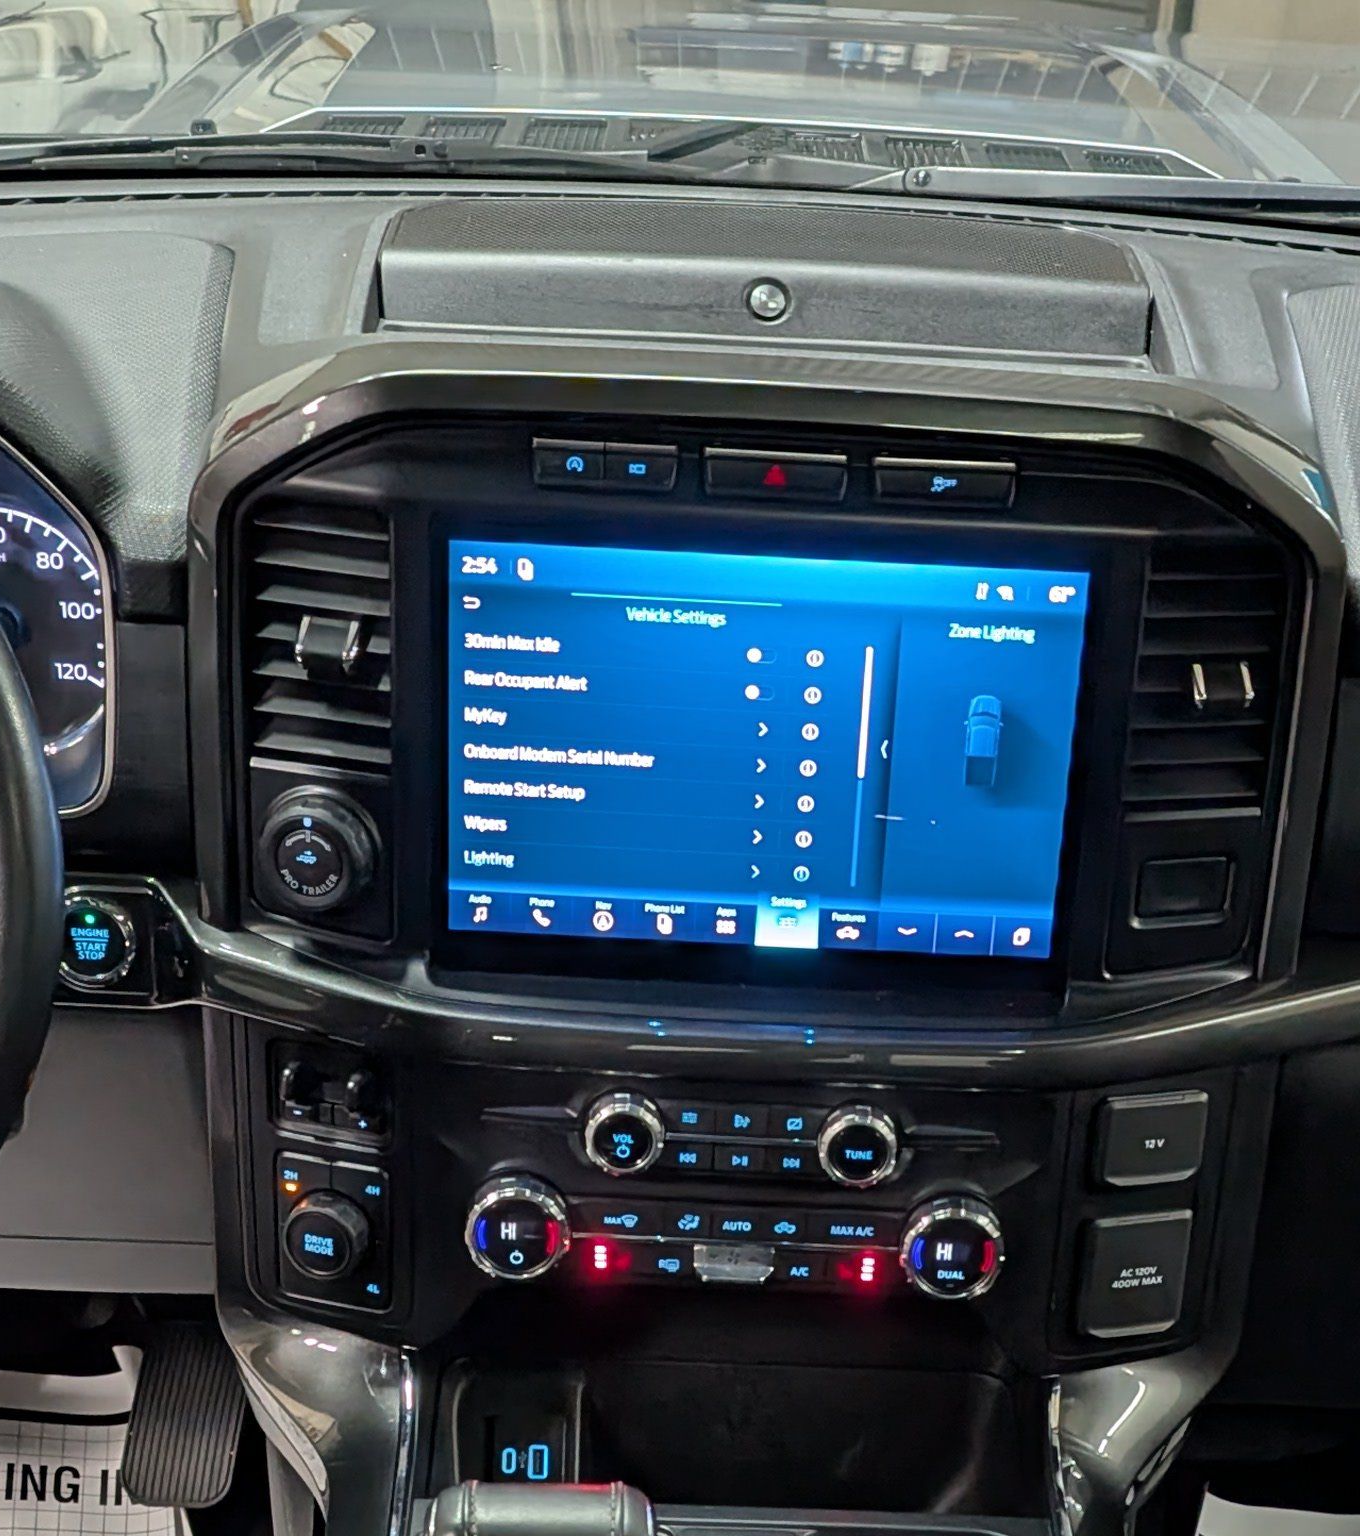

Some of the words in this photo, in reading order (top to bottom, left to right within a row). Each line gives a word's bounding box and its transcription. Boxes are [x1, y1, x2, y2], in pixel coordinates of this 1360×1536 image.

[36, 552, 64, 570] 80
[462, 556, 498, 574] 2:54
[58, 601, 95, 620] 100
[625, 606, 672, 623] Vehicle
[673, 609, 727, 628] Settings
[948, 622, 981, 639] Zone
[982, 625, 1035, 644] Lighting
[464, 633, 506, 650] 30min
[507, 635, 534, 651] Max
[535, 637, 560, 653] Idle
[54, 663, 88, 680] 120
[464, 670, 494, 686] Rear
[494, 672, 555, 690] Occupant
[556, 675, 587, 691] Alert
[464, 706, 507, 726] MyKey
[464, 743, 518, 760] Onboard
[519, 747, 567, 763] Modem
[567, 749, 603, 765] Serial
[604, 752, 654, 768] Number
[464, 779, 513, 796] Remote
[513, 782, 546, 798] Start
[547, 784, 585, 802] Setup
[464, 815, 507, 833] Wipers
[464, 850, 514, 868] Lighting
[281, 868, 299, 889] PRO
[302, 873, 339, 895] TRAILER
[529, 897, 555, 908] Phone
[771, 896, 807, 910] Settings
[645, 903, 669, 914] Phone
[670, 904, 685, 915] List
[831, 912, 866, 923] Features
[70, 927, 109, 938] ENGINE
[75, 942, 107, 951] START
[78, 951, 105, 960] STOP
[613, 1134, 634, 1144] VOL
[1157, 1138, 1165, 1148] V
[845, 1150, 872, 1160] TUNE
[284, 1170, 298, 1181] 2H
[365, 1185, 380, 1196] 4H
[501, 1222, 517, 1240] HI
[722, 1220, 751, 1231] AUTO
[830, 1225, 854, 1236] MAX
[855, 1226, 874, 1237] A/C
[304, 1234, 333, 1246] DRIVE
[304, 1244, 334, 1256] MODE
[936, 1242, 953, 1261] HI
[790, 1266, 809, 1277] A/C
[937, 1270, 965, 1280] DUAL
[1120, 1269, 1133, 1278] AC
[1134, 1266, 1157, 1277] 120V
[1111, 1278, 1140, 1289] 400W
[1141, 1275, 1163, 1286] MAX
[366, 1283, 380, 1295] 4L
